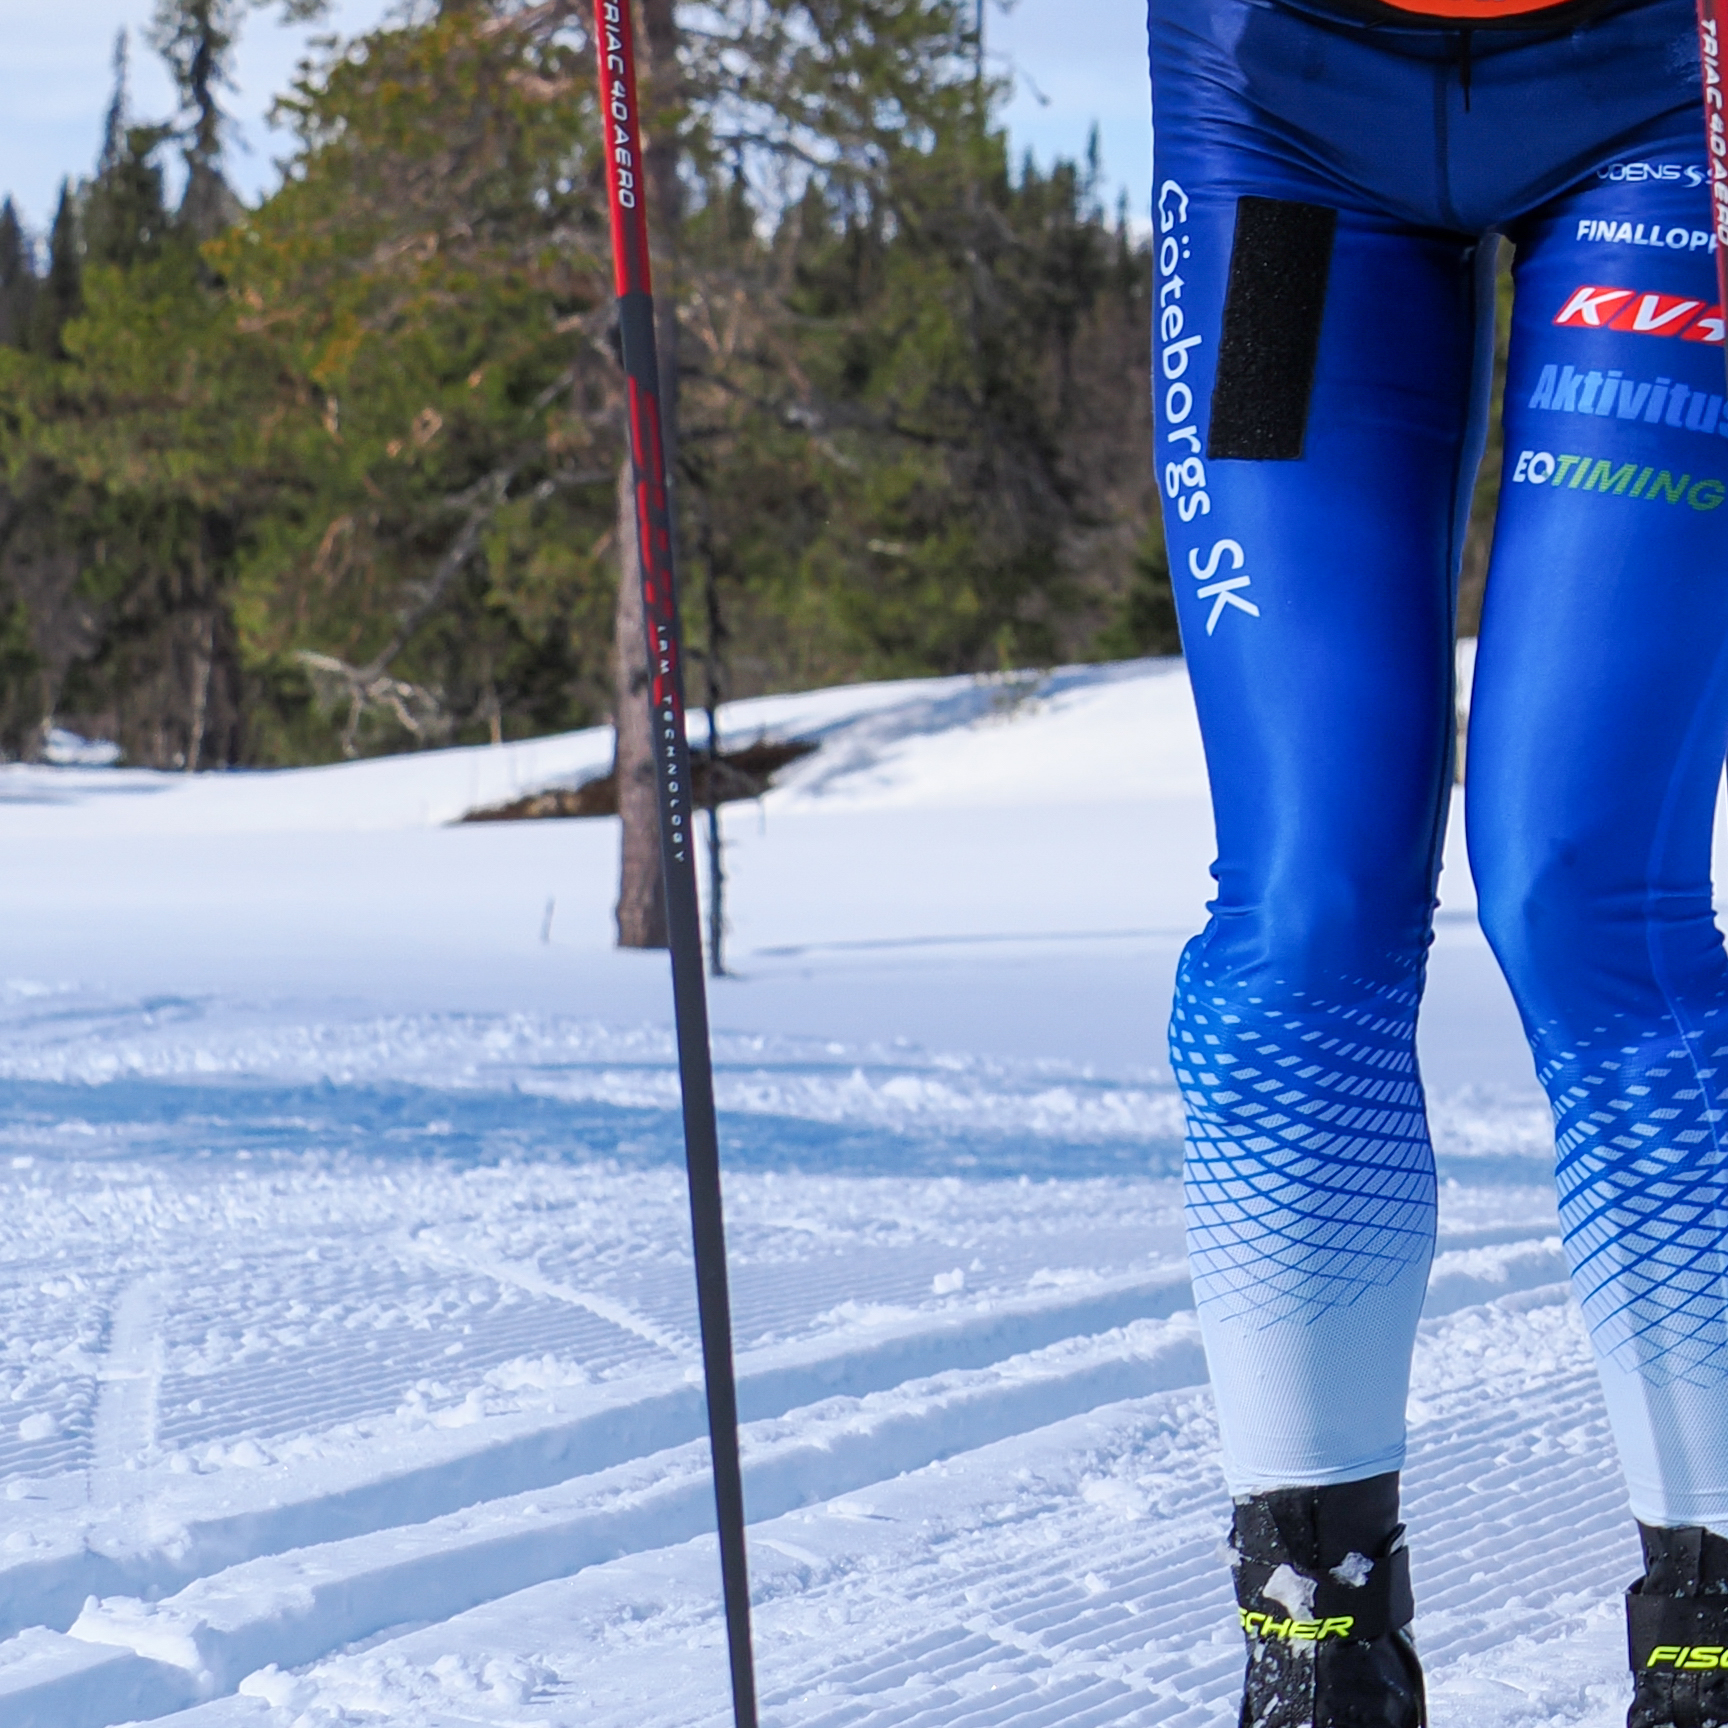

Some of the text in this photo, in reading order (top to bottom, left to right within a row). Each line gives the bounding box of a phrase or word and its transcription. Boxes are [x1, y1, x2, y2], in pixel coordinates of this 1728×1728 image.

[607, 78, 628, 121] 4.0
[1700, 18, 1724, 115] TRIAC
[611, 124, 636, 210] AERO
[1597, 161, 1683, 182] UDENS
[1159, 177, 1260, 638] Göteborgs SK
[661, 693, 686, 864] TECHNOLOGY
